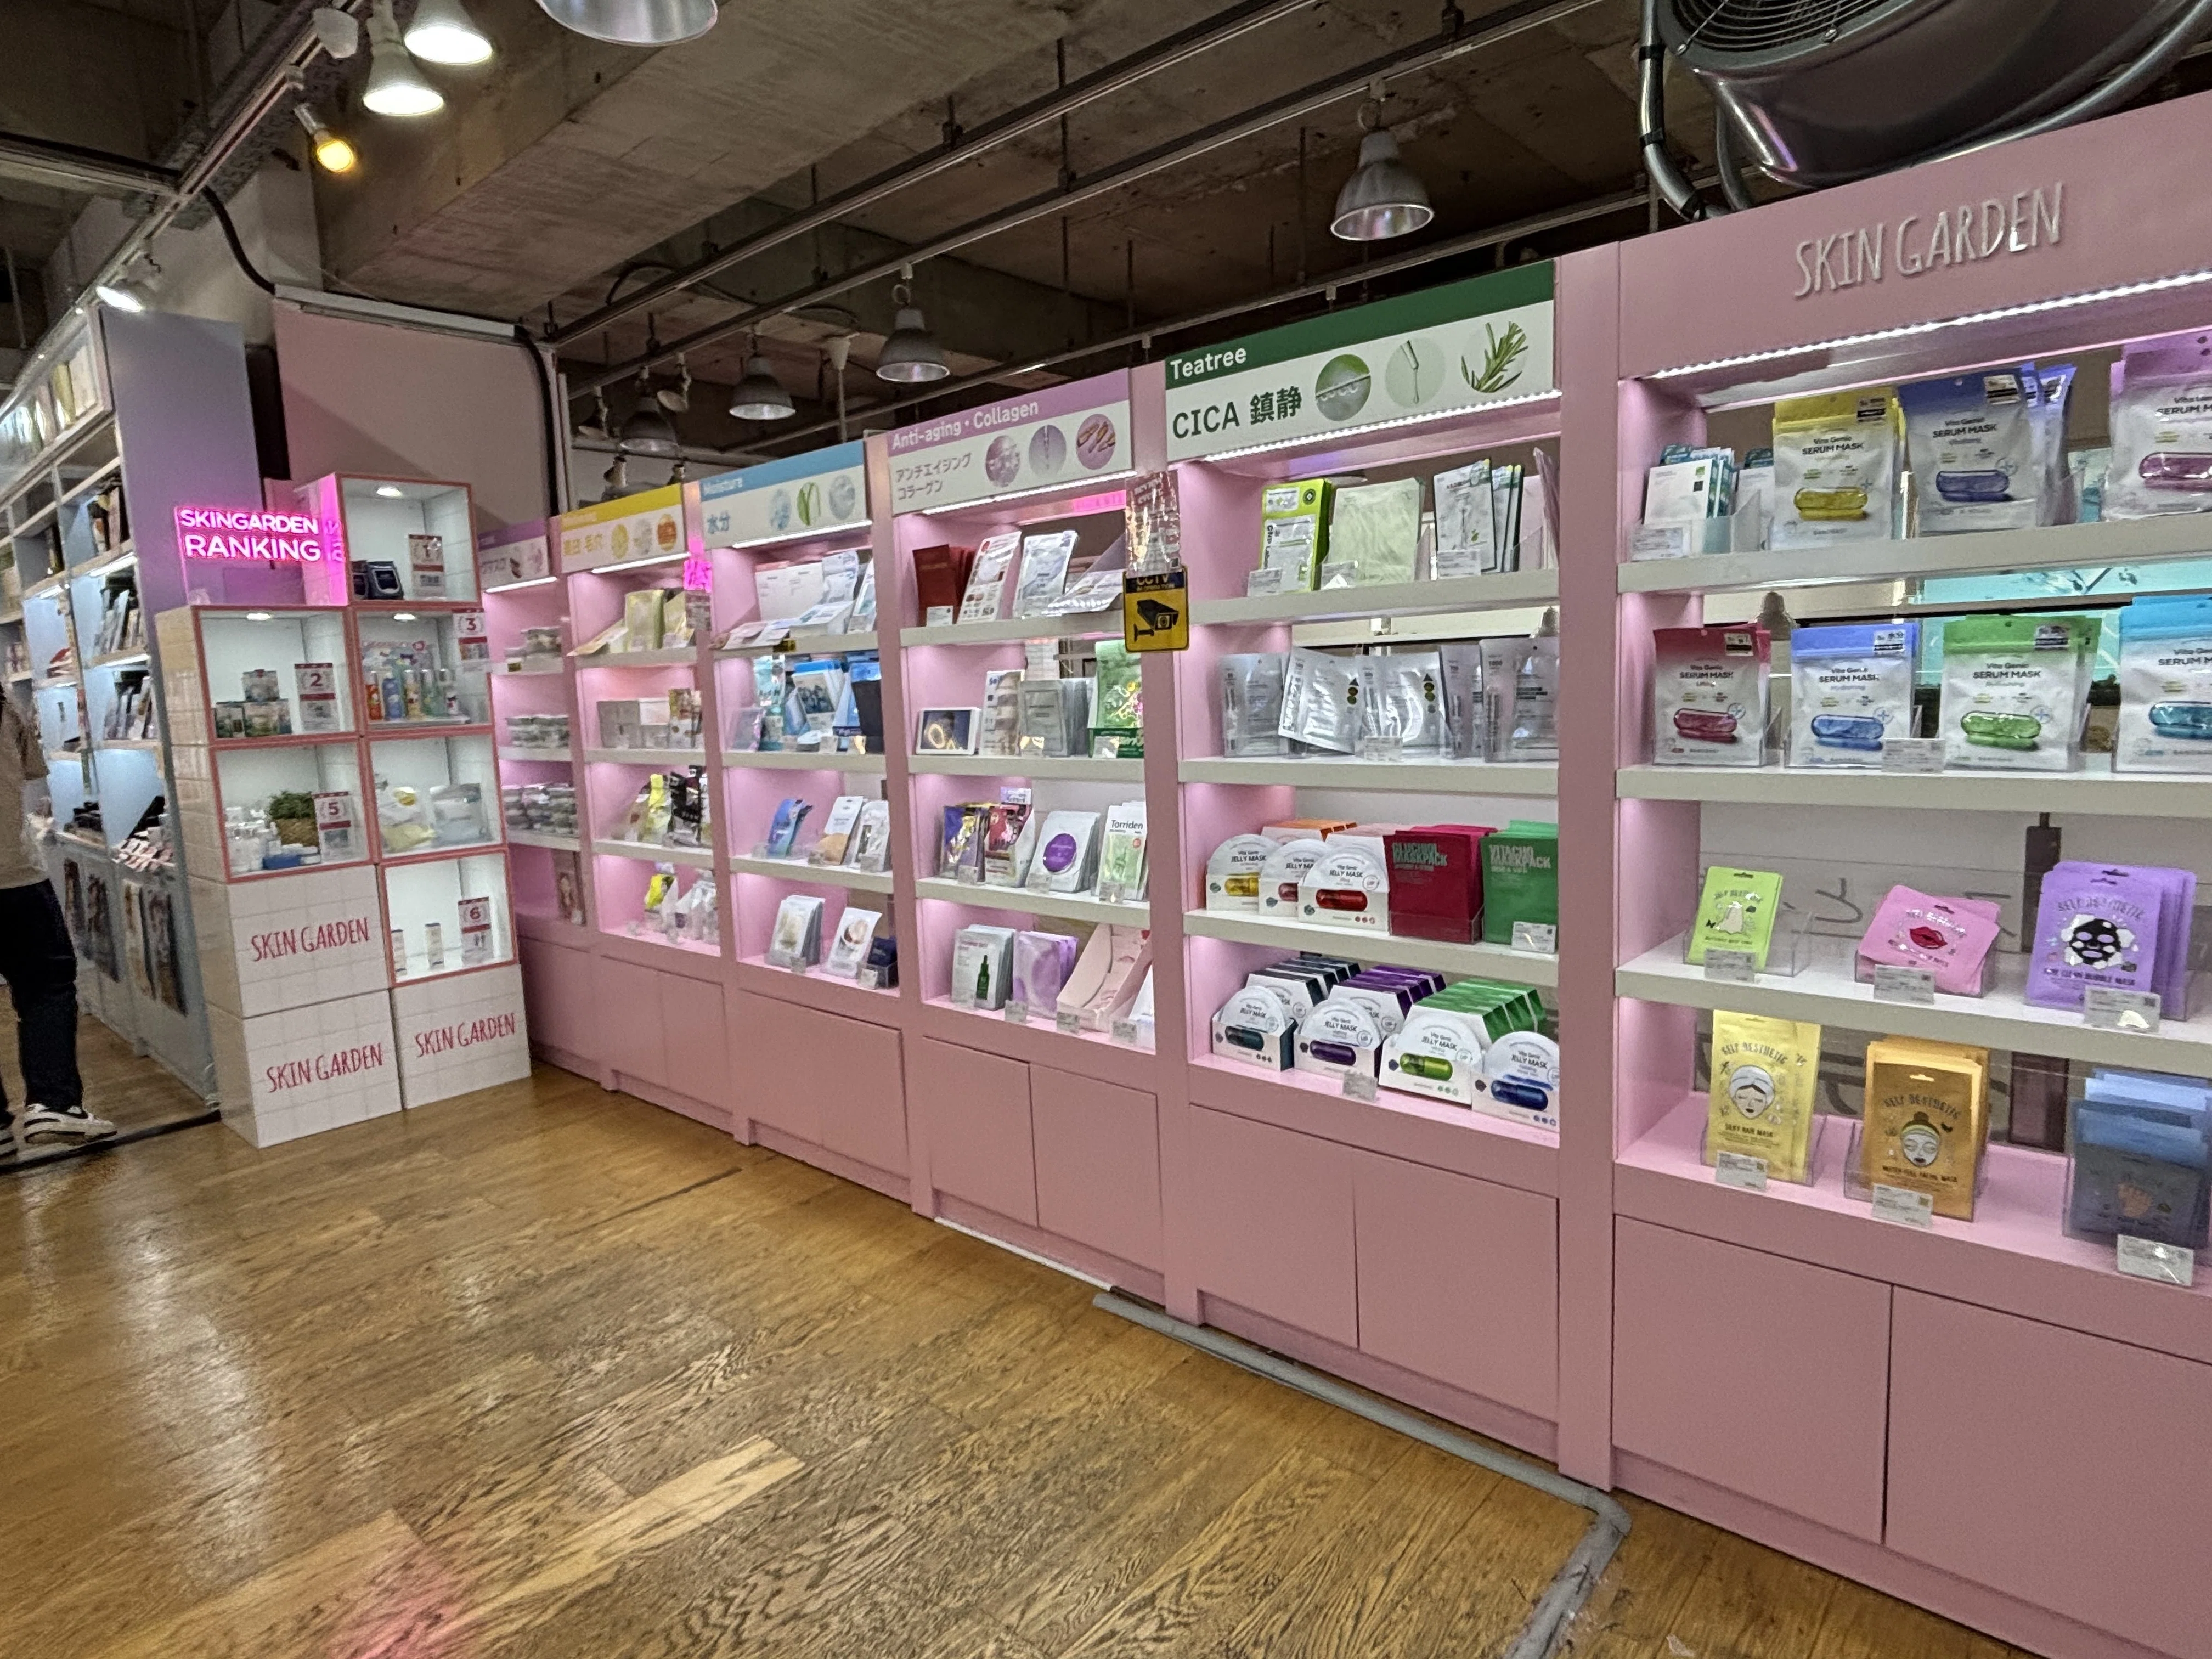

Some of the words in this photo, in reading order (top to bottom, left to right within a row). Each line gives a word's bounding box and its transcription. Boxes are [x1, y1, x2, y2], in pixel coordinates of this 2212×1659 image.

[1794, 223, 1885, 299] SKIN
[1895, 182, 2063, 275] GARDEN
[1170, 346, 1247, 380] Teatree
[1172, 401, 1240, 439] CICA
[1249, 385, 1302, 424] 鎮静
[891, 421, 961, 450] Anti-aging
[973, 402, 1039, 429] Collagen
[1933, 427, 1967, 438] SERUM
[1968, 424, 1997, 433] MASK
[1802, 444, 1834, 455] SERUM
[1836, 442, 1864, 451] MASK
[180, 509, 319, 534] SKINGARDEN
[184, 534, 321, 561] RANKING
[466, 618, 477, 631] 3
[2158, 657, 2201, 665] SERUM
[310, 673, 323, 687] 2
[1819, 675, 1850, 683] SERUM
[1852, 673, 1880, 681] MASK
[328, 802, 340, 816] 5
[1111, 819, 1143, 830] Torriden
[469, 906, 482, 920] 6
[250, 929, 297, 962] SKIN
[301, 917, 370, 953] GARDEN
[1324, 1020, 1339, 1029] JELLY
[1340, 1024, 1357, 1032] MASK
[415, 1025, 454, 1058] SKIN
[457, 1012, 516, 1047] GARDEN
[1421, 1036, 1437, 1046] JELLY
[1438, 1040, 1457, 1051] MASK
[266, 1057, 311, 1094] SKIN
[315, 1042, 383, 1080] GARDEN
[1511, 1054, 1527, 1063] JELLY
[1528, 1058, 1548, 1069] MASK
